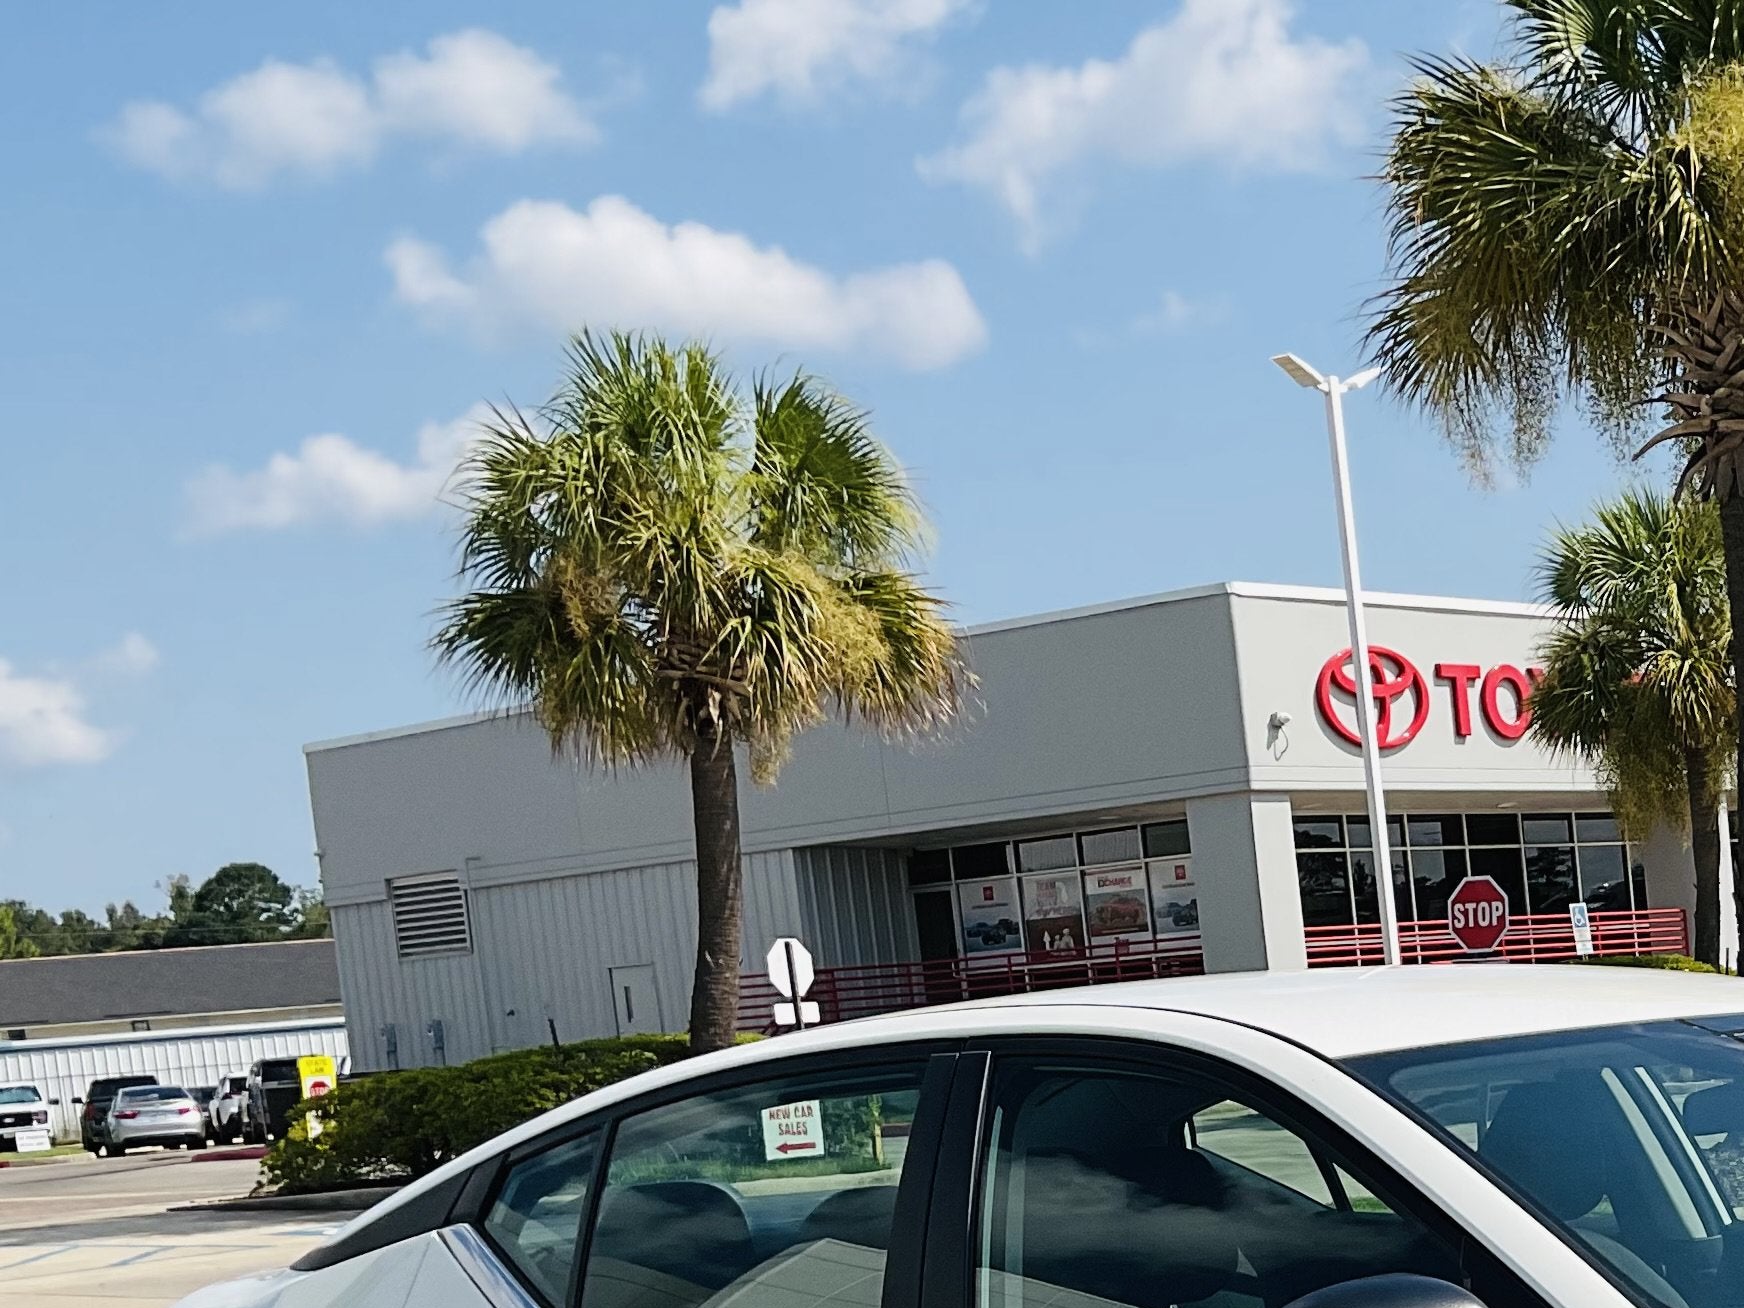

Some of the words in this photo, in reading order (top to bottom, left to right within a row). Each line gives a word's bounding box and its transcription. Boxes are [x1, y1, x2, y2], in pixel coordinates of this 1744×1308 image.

[1453, 901, 1503, 929] STOP
[769, 1107, 790, 1120] NEW
[795, 1105, 814, 1118] CAR
[779, 1122, 808, 1136] SALES
